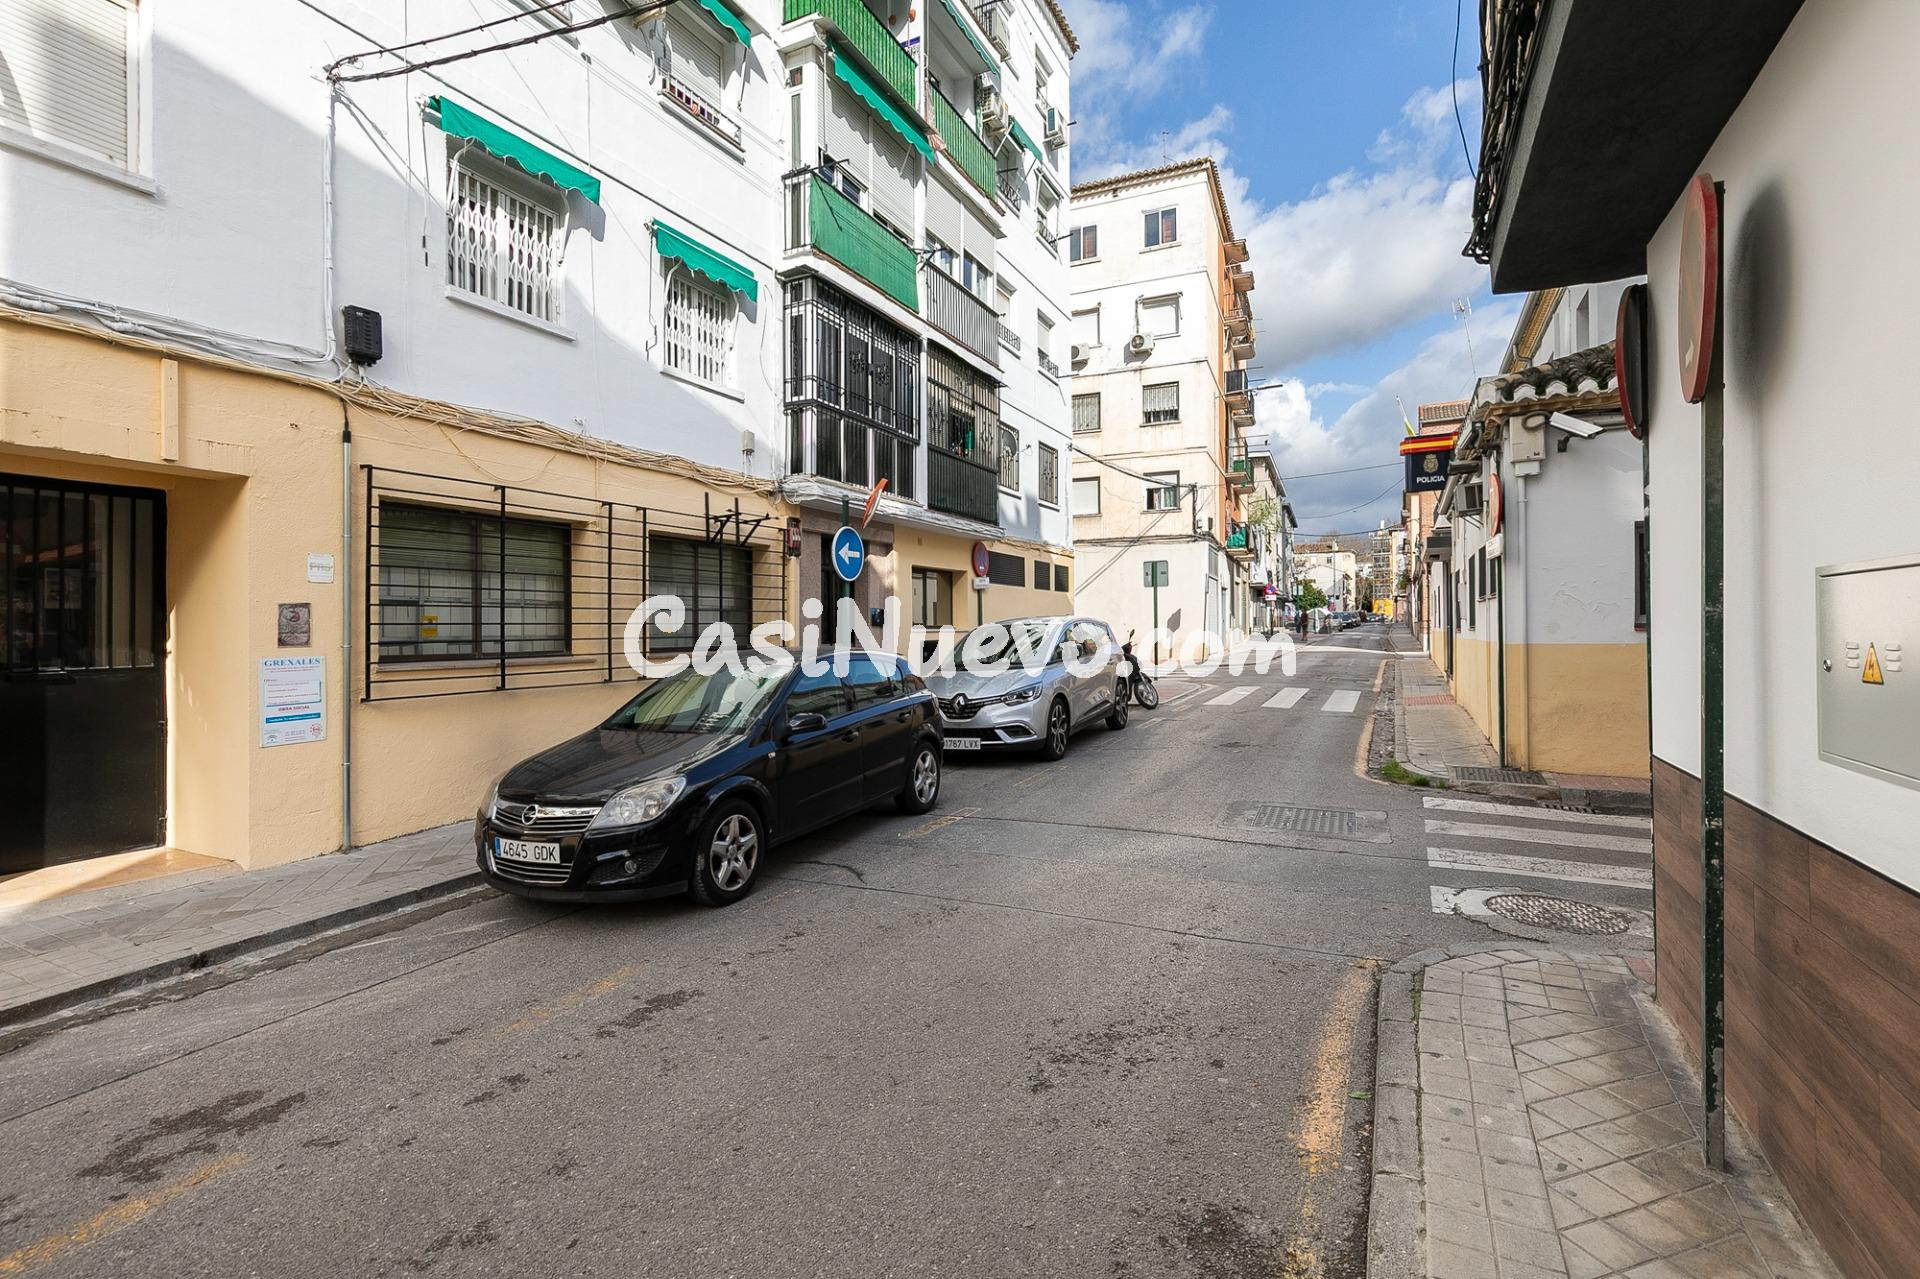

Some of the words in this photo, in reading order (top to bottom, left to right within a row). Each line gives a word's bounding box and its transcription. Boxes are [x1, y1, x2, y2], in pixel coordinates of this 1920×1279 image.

[1416, 475, 1446, 484] POLICIA
[503, 841, 528, 859] 4645
[534, 845, 557, 861] GDK
